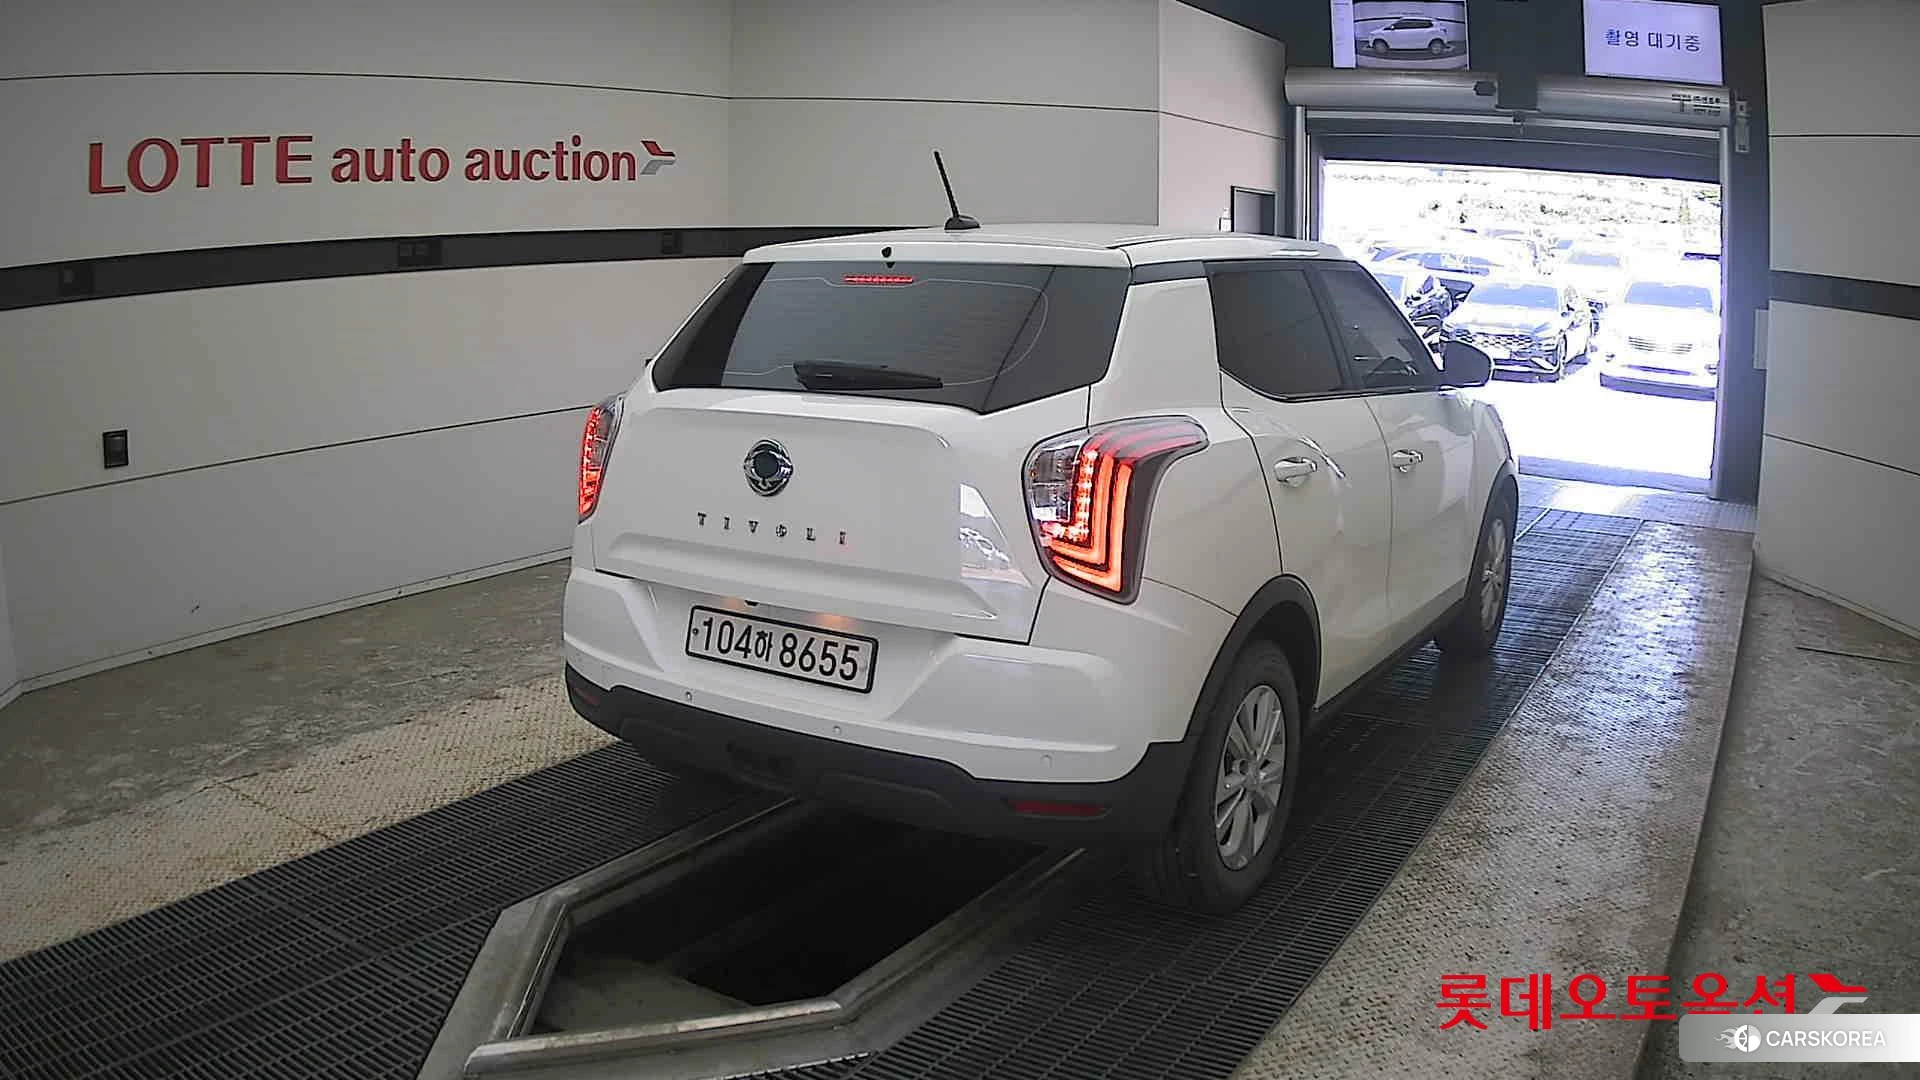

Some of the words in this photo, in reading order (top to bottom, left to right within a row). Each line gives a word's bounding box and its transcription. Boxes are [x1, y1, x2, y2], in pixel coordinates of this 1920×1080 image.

[1648, 32, 1701, 52] 대기중
[88, 135, 313, 194] LOTTE
[331, 137, 450, 182] auto
[464, 135, 637, 182] auction
[697, 511, 848, 545] TIVOLI
